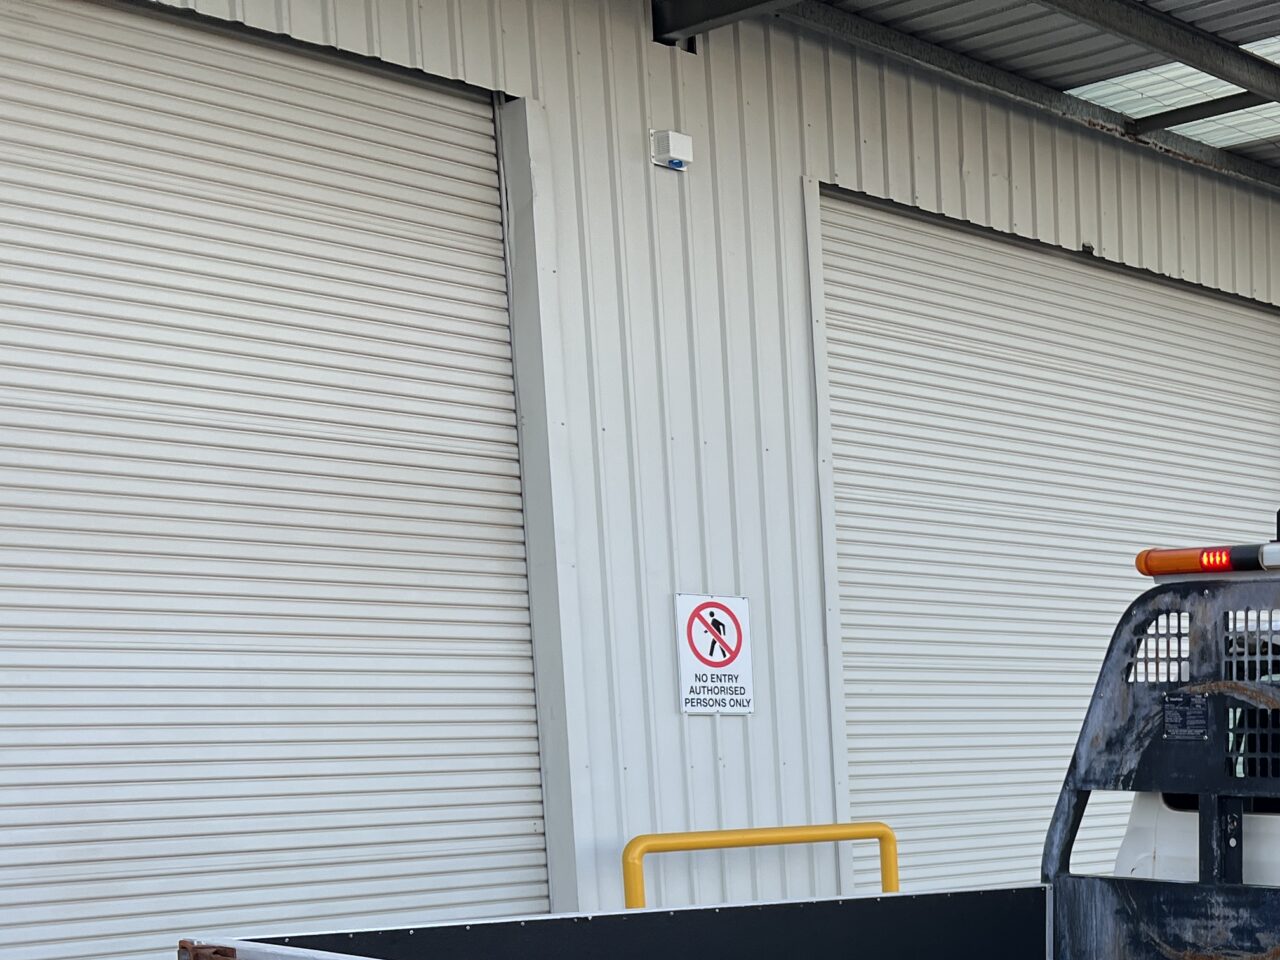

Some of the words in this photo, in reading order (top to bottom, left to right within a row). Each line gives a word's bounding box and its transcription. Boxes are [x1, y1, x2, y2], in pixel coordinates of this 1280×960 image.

[695, 673, 708, 682] NO
[711, 674, 739, 683] ENTRY
[689, 686, 746, 695] AUTHORISED
[684, 698, 727, 707] PERSONS
[729, 698, 751, 707] ONLY
